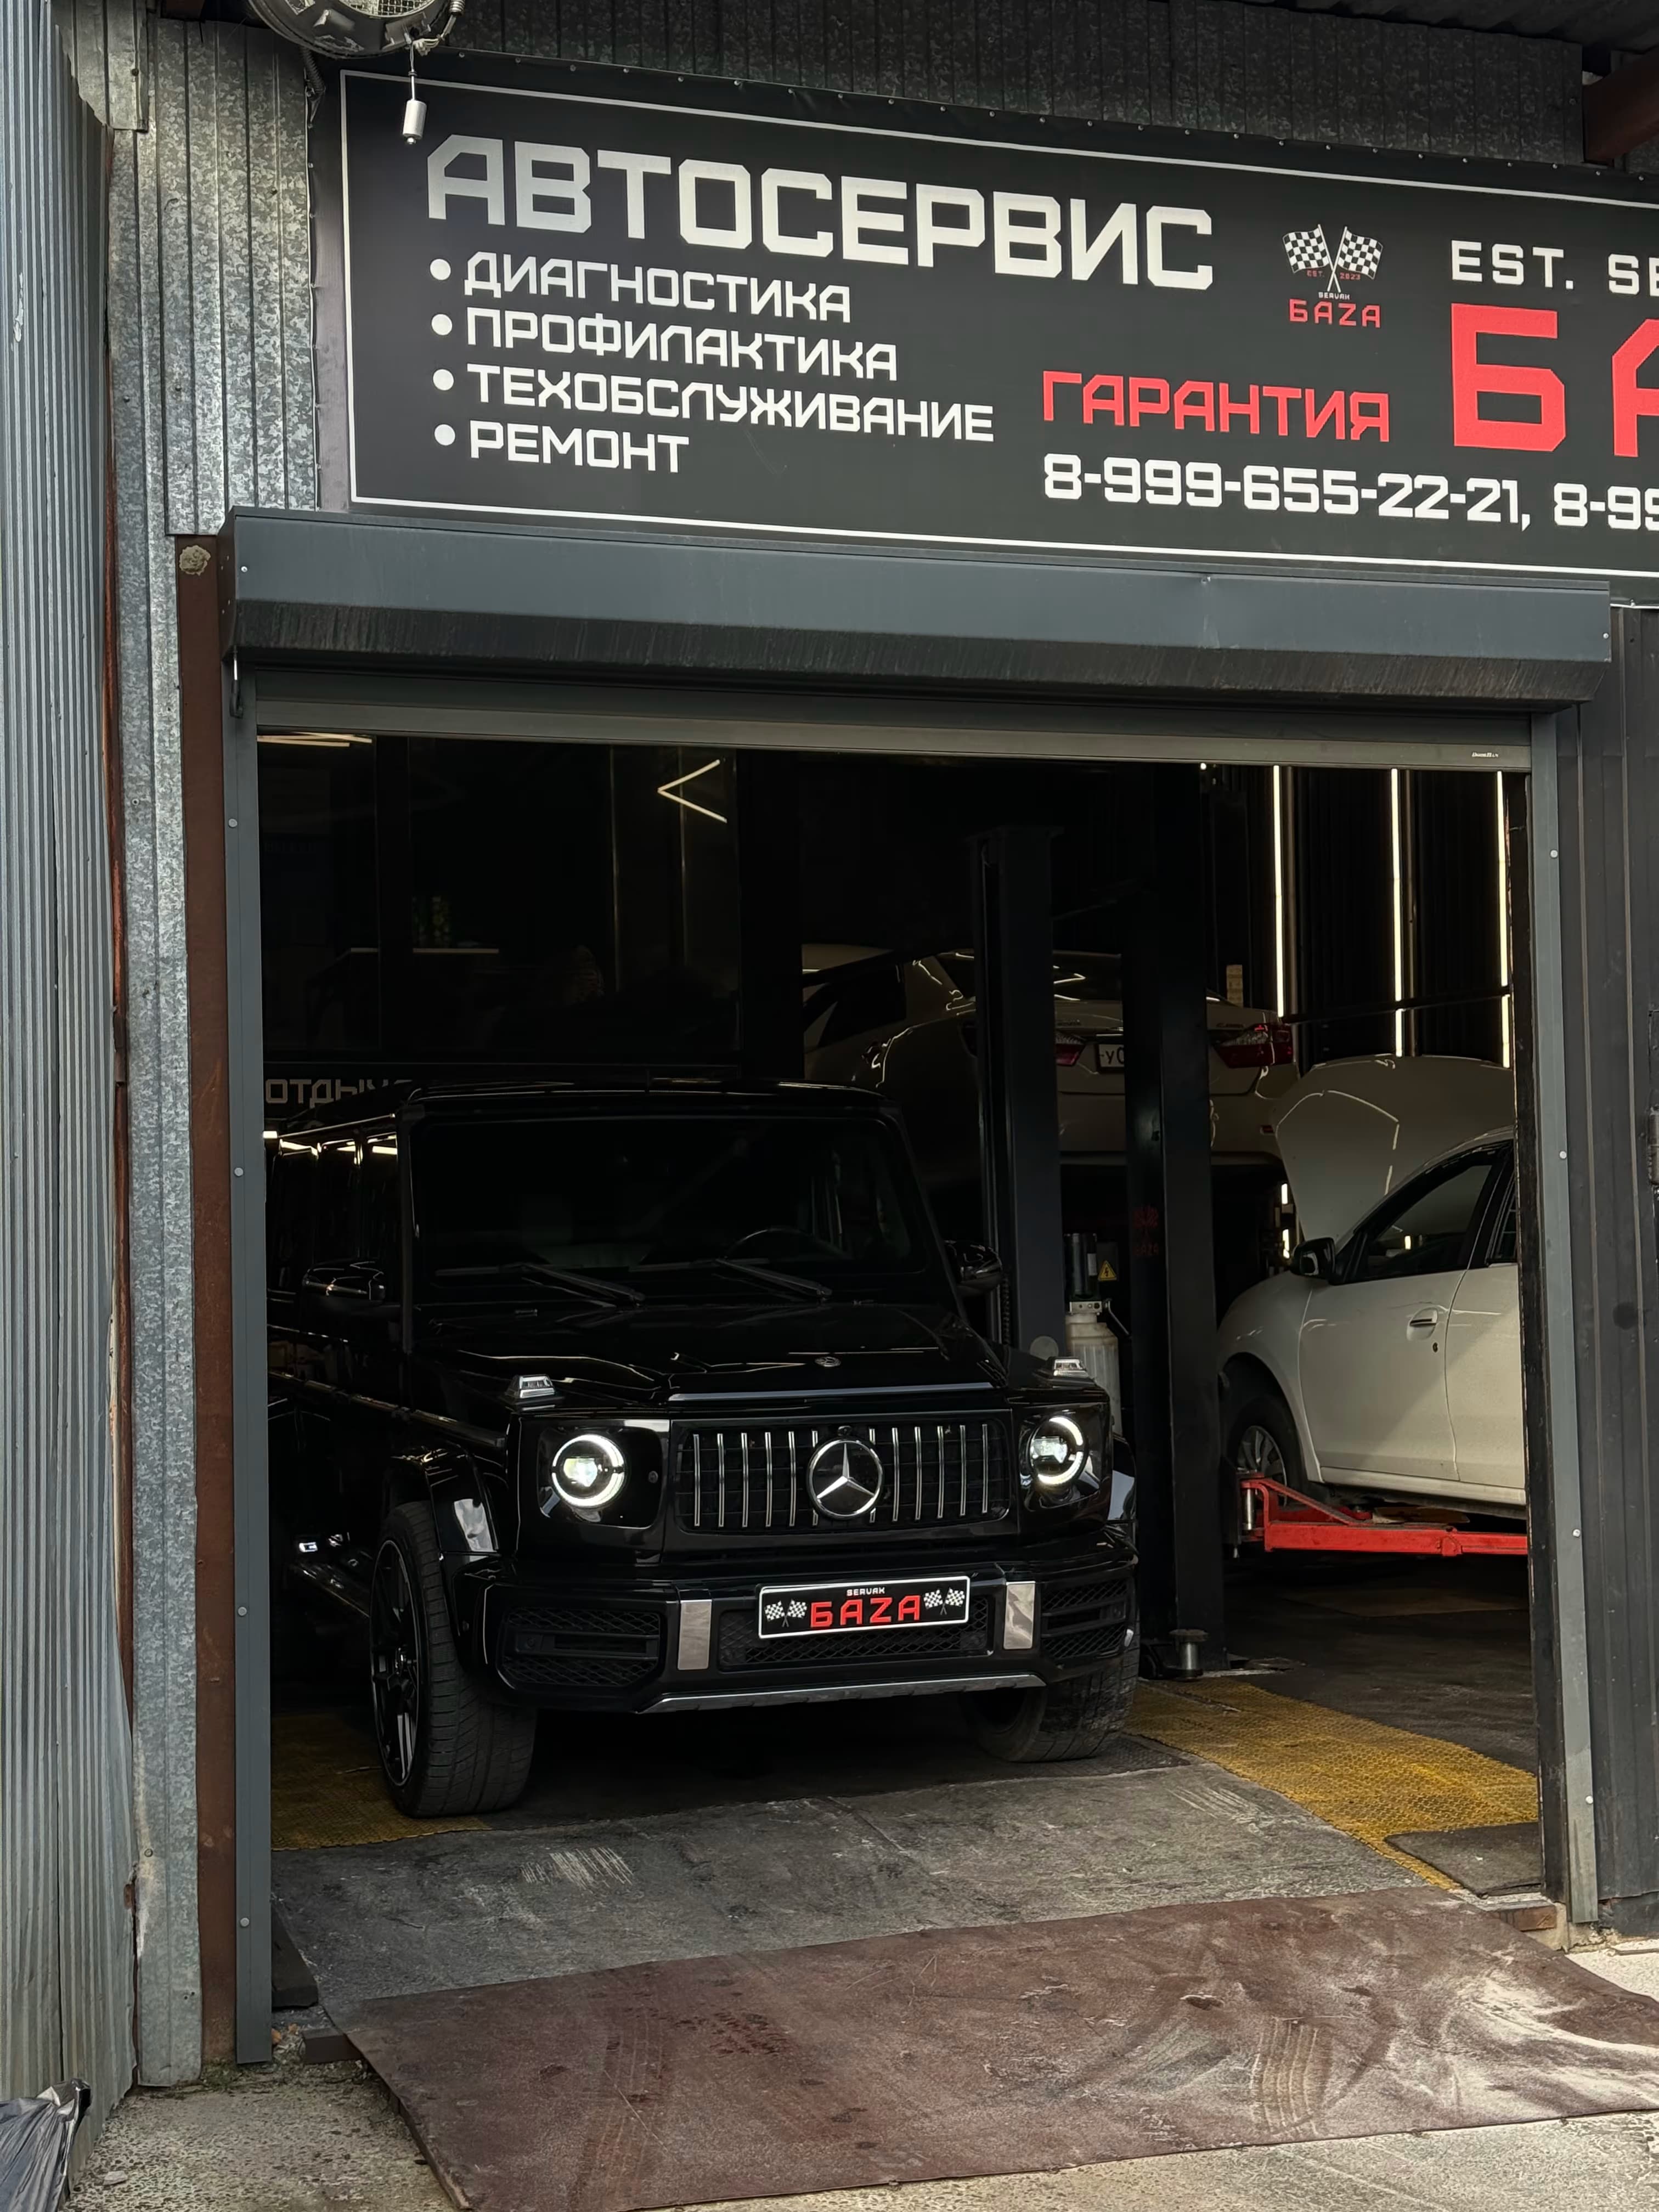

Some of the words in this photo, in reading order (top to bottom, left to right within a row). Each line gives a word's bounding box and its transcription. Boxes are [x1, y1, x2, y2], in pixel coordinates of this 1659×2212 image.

[428, 134, 1213, 290] АВТОСЕРВИС
[464, 251, 850, 323] ДИАГНОСТИКА
[1451, 240, 1573, 290] EST.
[467, 307, 897, 381] ПРОФИЛАКТИКА
[467, 363, 994, 442] ТЕХОБСЛУЖИВАНИЕ
[1043, 371, 1390, 442] ГАРАНТИЯ
[470, 420, 690, 473] РЕМОНТ
[1044, 453, 1531, 532] 8-999-655-22-21,
